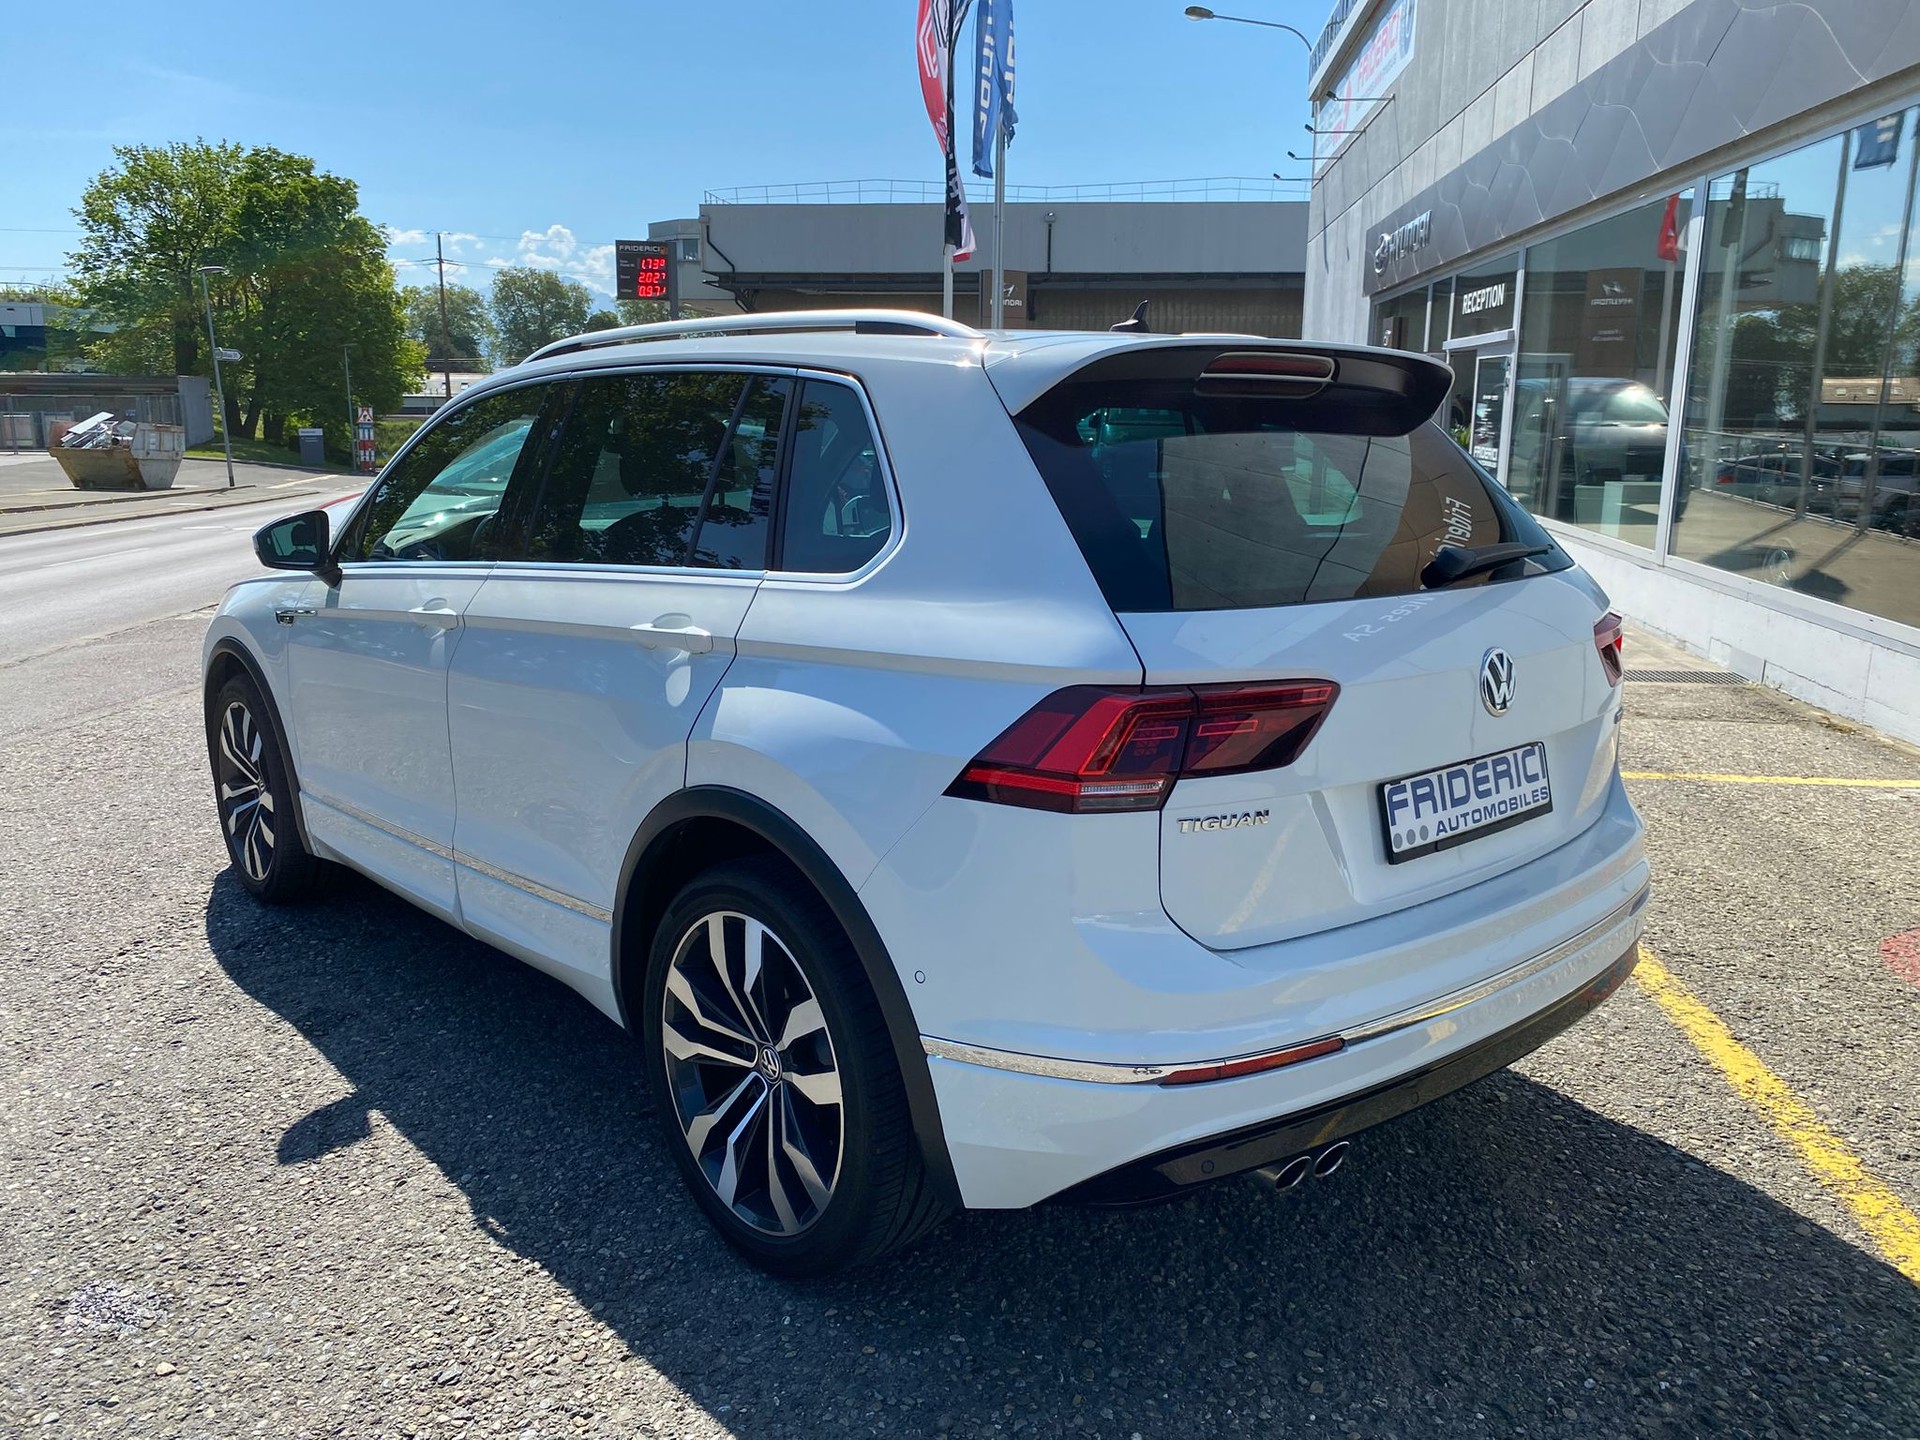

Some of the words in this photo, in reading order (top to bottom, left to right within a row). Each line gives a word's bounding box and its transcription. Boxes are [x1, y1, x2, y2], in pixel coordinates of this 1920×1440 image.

[1462, 283, 1505, 315] RECEPTION
[1388, 745, 1546, 827] FRIDERICI
[1176, 809, 1270, 834] TIGUAN
[1436, 786, 1549, 838] AUTOMOBILES
